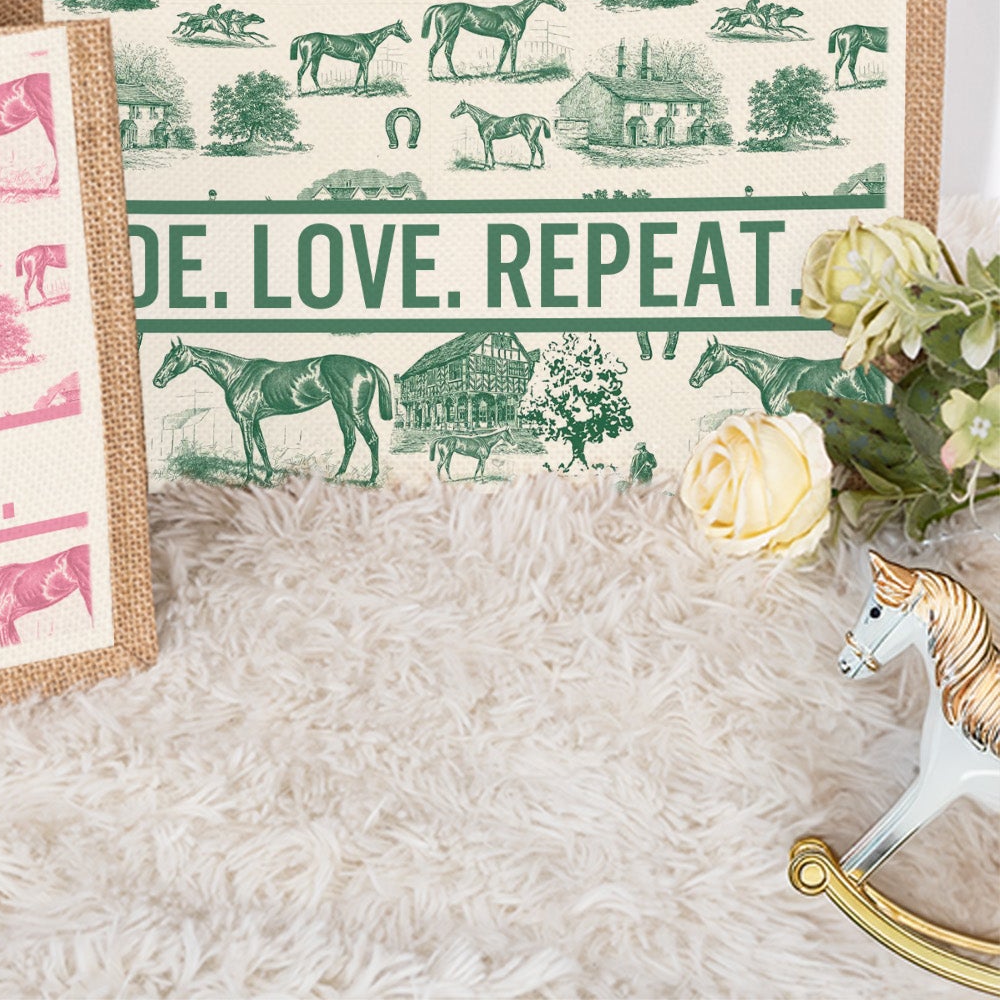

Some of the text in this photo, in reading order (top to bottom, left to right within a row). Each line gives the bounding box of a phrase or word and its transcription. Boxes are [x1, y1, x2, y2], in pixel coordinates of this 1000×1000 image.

[127, 219, 803, 310] DE. LOVE. REPEAT.
